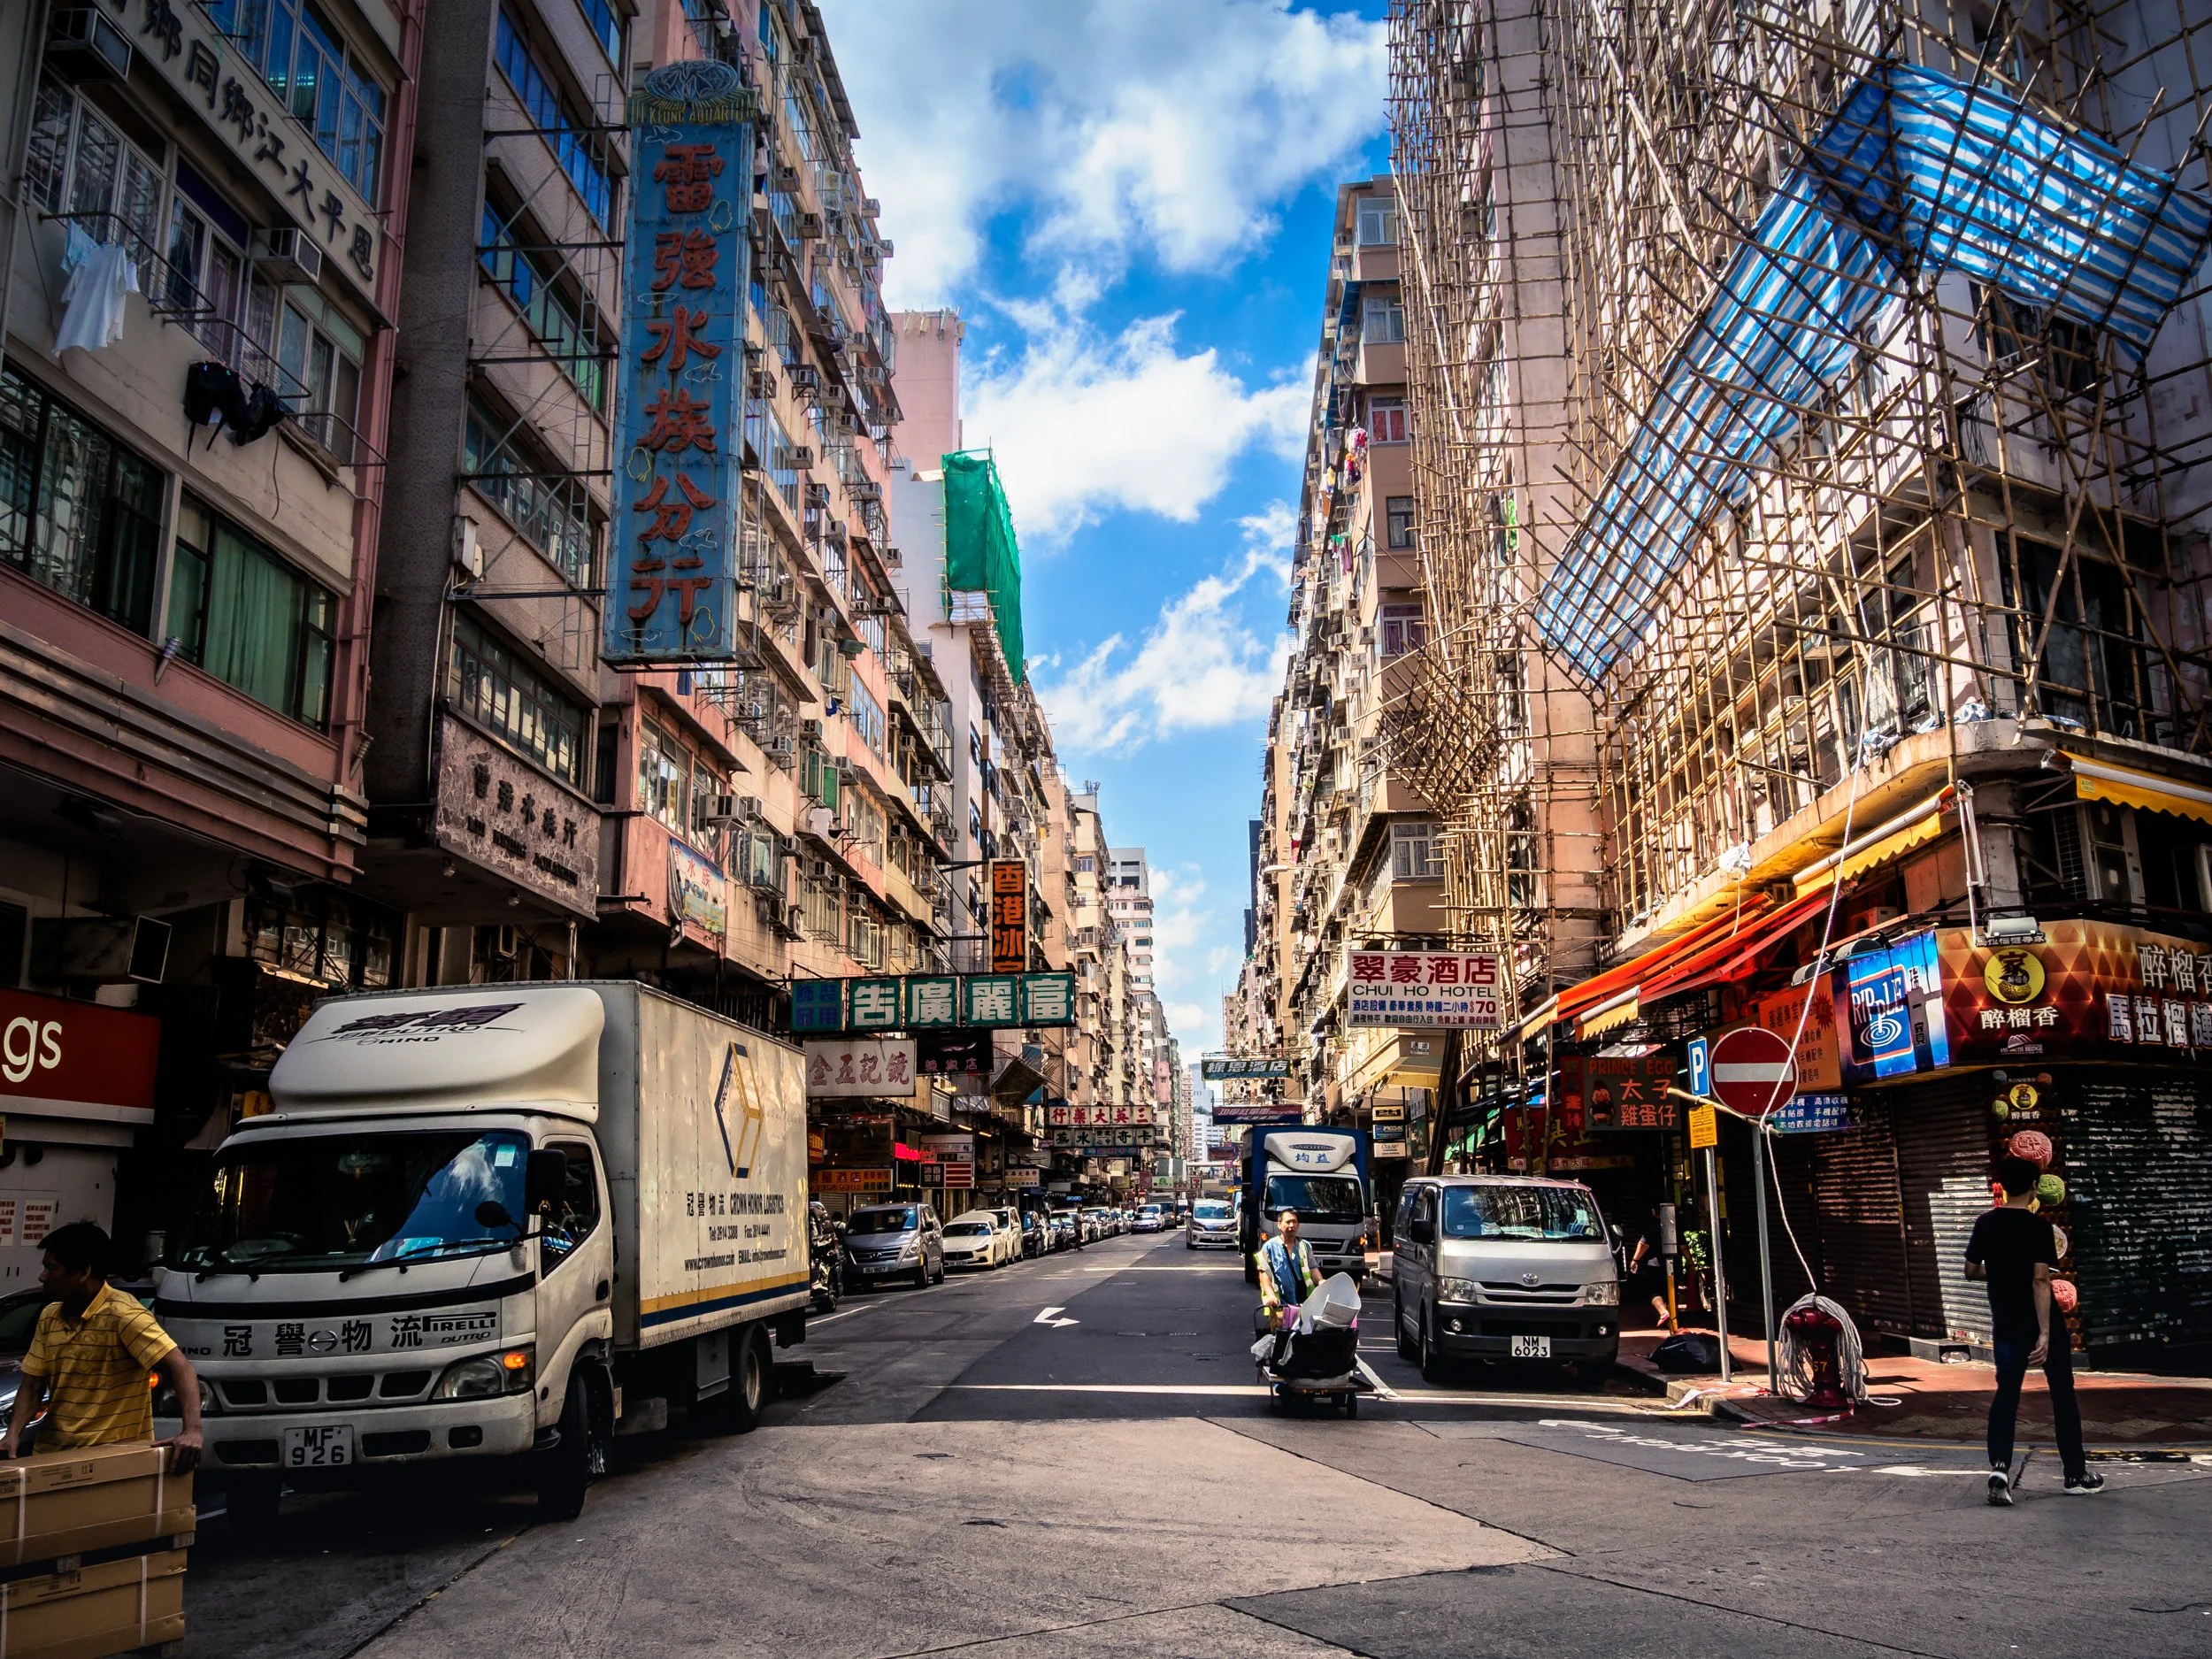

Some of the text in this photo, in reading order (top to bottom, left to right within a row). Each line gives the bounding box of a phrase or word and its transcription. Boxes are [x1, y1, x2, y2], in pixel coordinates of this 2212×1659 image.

[1352, 955, 1497, 985] 翠豪酒店
[1352, 985, 1496, 998] CHUI HO HOTEL
[1979, 1006, 2059, 1030] 醉榴香
[379, 1036, 441, 1045] HINO
[1588, 1060, 1674, 1075] PRINCE EGG
[1692, 1046, 1704, 1091] P
[1619, 1078, 1671, 1101] 太子
[1620, 1103, 1677, 1127] 雞蛋仔
[764, 1194, 784, 1215] LOGISTICS
[421, 1311, 497, 1333] PIRELLI
[441, 1331, 492, 1344] DUTRO
[1523, 1336, 1540, 1347] NM
[1514, 1346, 1548, 1357] 6023
[303, 1428, 334, 1448] MF
[291, 1446, 345, 1466] 926
